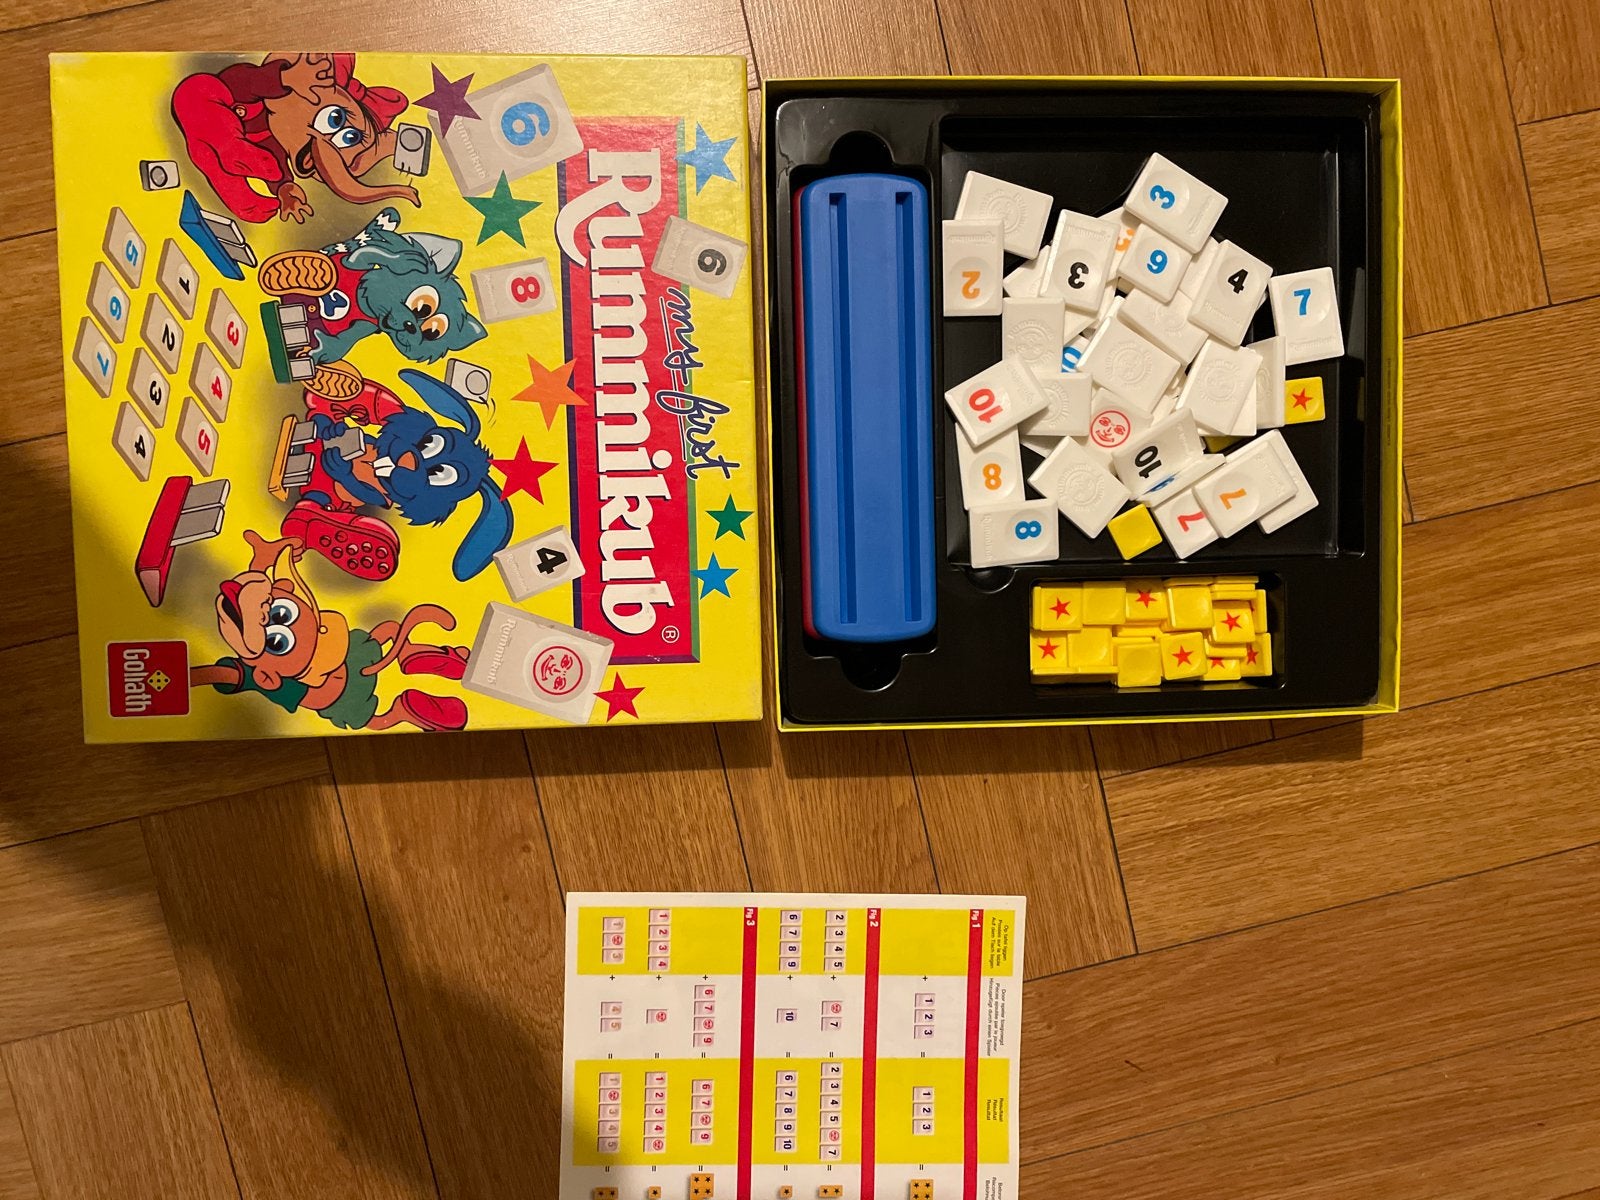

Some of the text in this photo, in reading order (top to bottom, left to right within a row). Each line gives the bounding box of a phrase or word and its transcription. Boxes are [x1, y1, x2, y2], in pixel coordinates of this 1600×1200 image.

[501, 102, 550, 146] 6
[1149, 184, 1176, 210] 3
[698, 248, 727, 276] 6
[1068, 262, 1090, 290] 3
[511, 276, 540, 303] 8
[962, 271, 980, 300] 2
[1228, 268, 1248, 294] 4
[96, 239, 138, 376] 5 6 7
[1293, 288, 1312, 316] 7
[134, 276, 191, 459] 1 2 3 4
[198, 322, 240, 455] 3 4 5
[554, 147, 675, 636] Rummikub
[656, 287, 740, 480] my first
[969, 388, 1004, 424] 10
[1134, 446, 1162, 478] 10
[982, 463, 1002, 490] 8
[1220, 488, 1247, 510] 7
[1015, 520, 1042, 540] 8
[1177, 510, 1206, 532] 7
[536, 546, 568, 575] 4
[122, 648, 152, 713] Goliath
[745, 908, 754, 919] Fig
[869, 909, 877, 919] Fig
[971, 910, 979, 920] Fig
[786, 1012, 793, 1022] 10
[784, 1140, 791, 1150] 10
